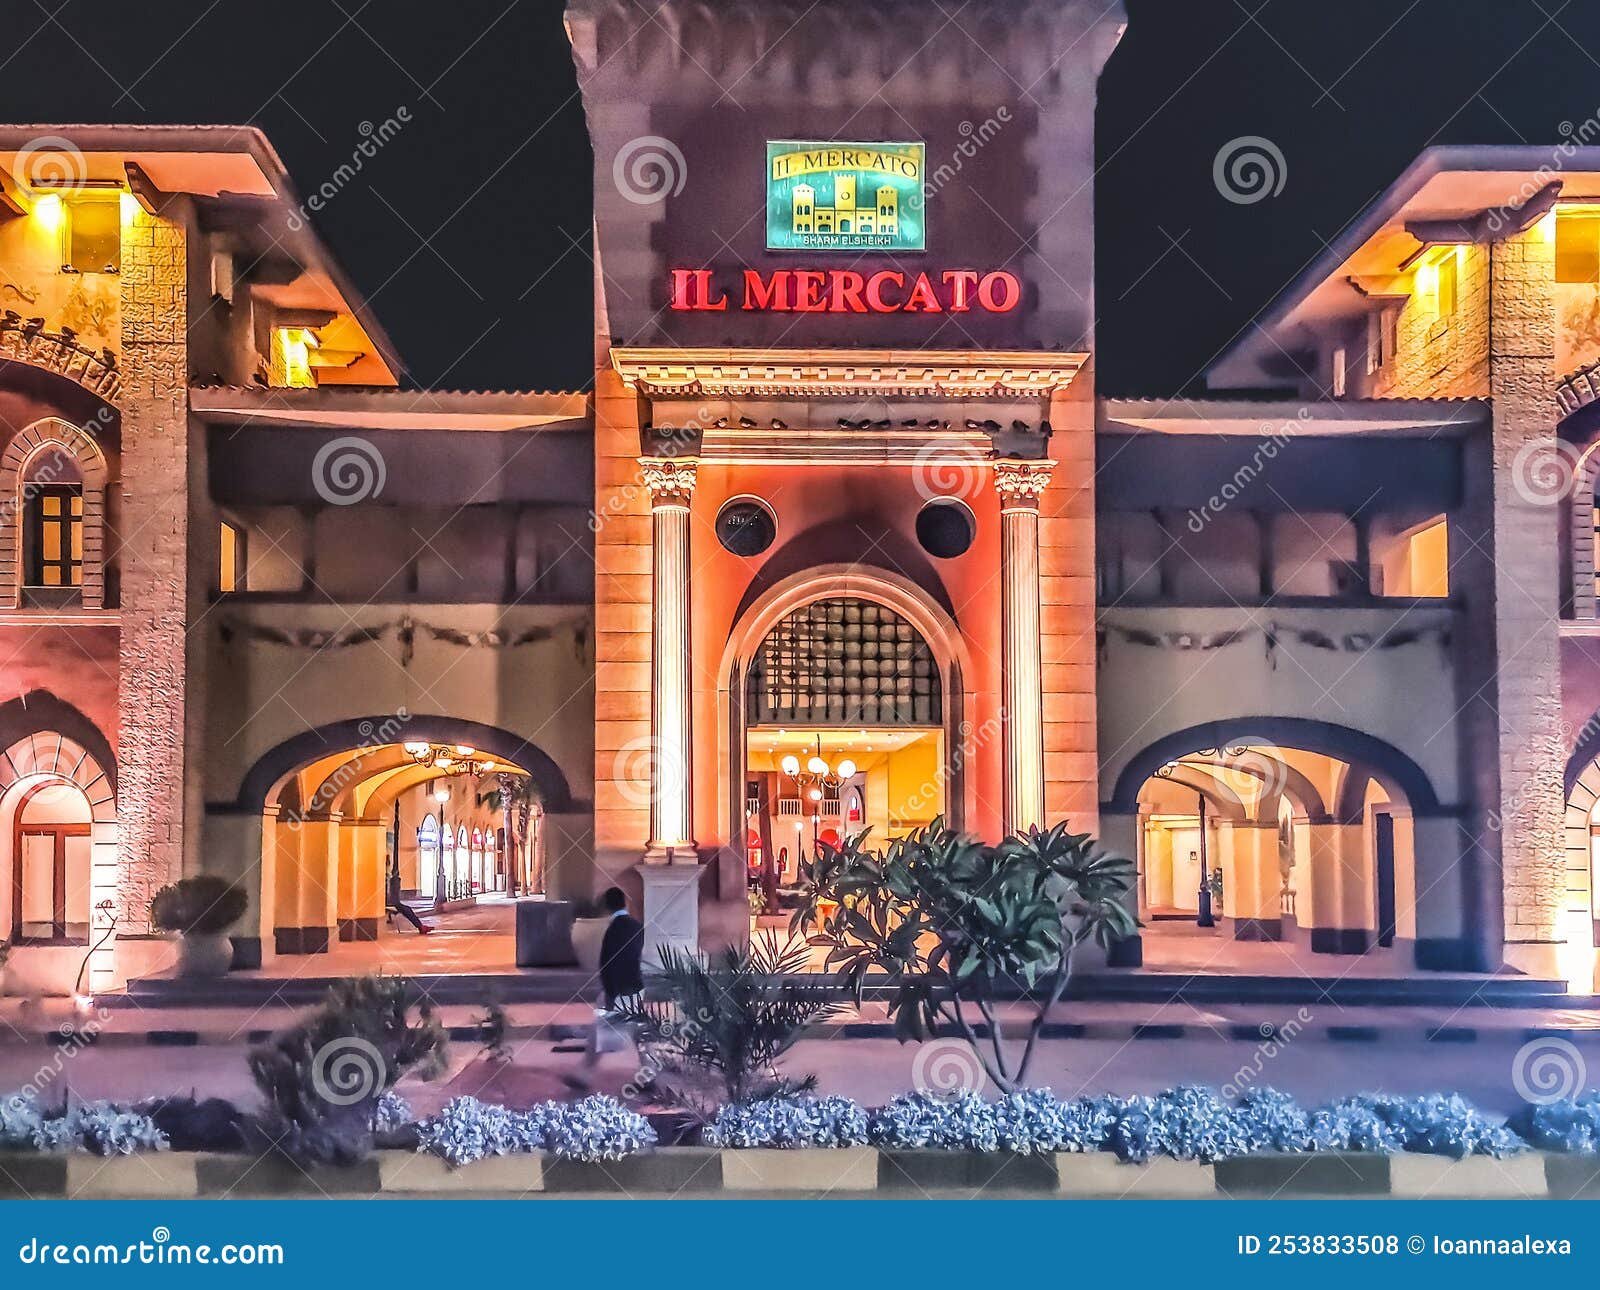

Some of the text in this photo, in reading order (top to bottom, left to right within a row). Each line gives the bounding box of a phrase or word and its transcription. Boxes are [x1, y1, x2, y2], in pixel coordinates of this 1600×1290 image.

[804, 150, 917, 178] MERCATO
[803, 235, 892, 246] SHARM ELSHEIKH
[671, 269, 1021, 313] IL MERCATO
